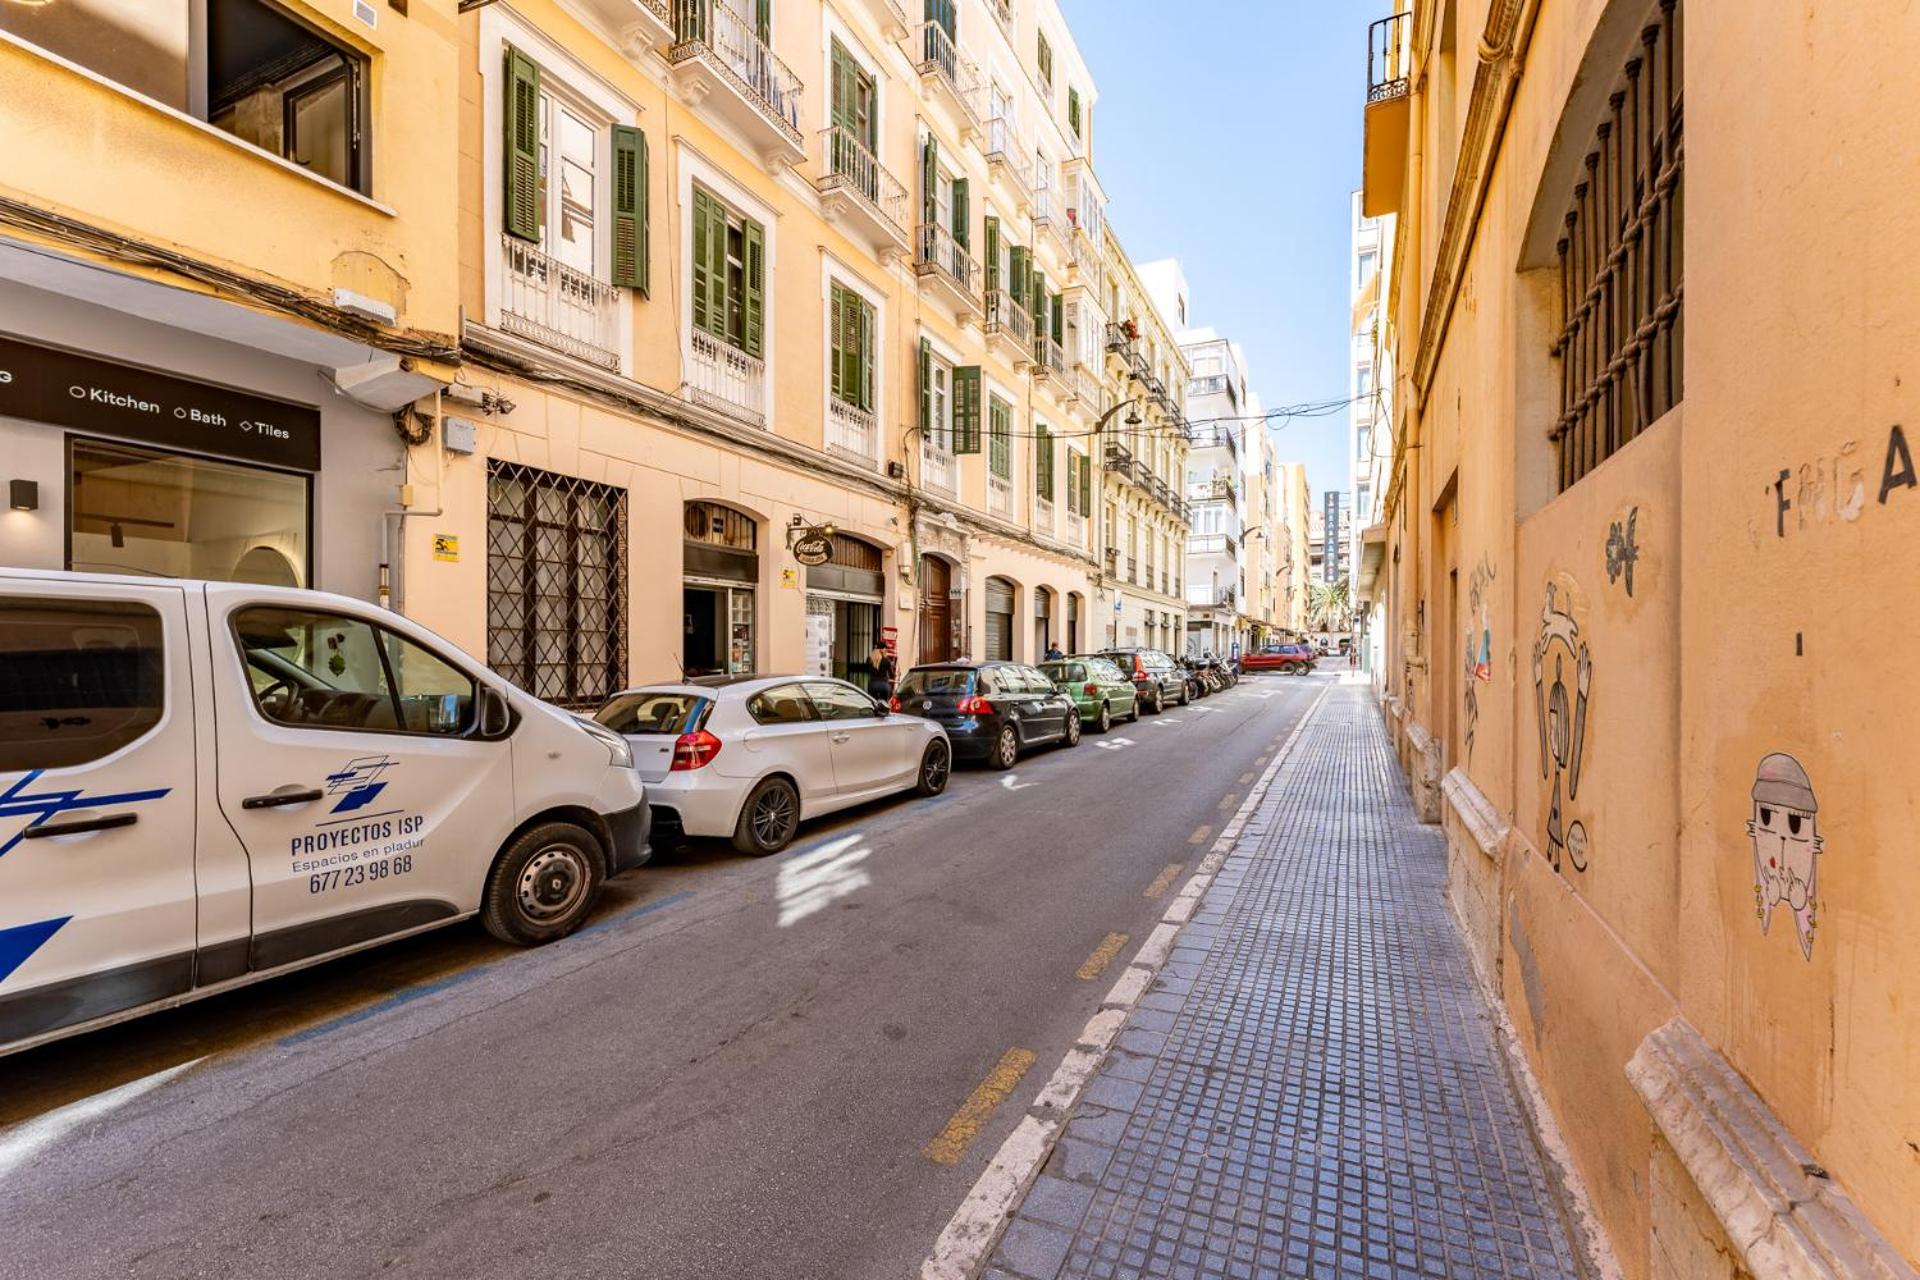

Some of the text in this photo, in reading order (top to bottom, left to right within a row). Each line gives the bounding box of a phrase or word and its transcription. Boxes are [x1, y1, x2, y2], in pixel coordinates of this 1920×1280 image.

[90, 387, 290, 439] Kitchen Bath Tiles
[291, 815, 424, 856] PROYECTOS ISP
[292, 839, 424, 873] Espacios en pladur
[310, 854, 412, 894] 677 23 98 68
